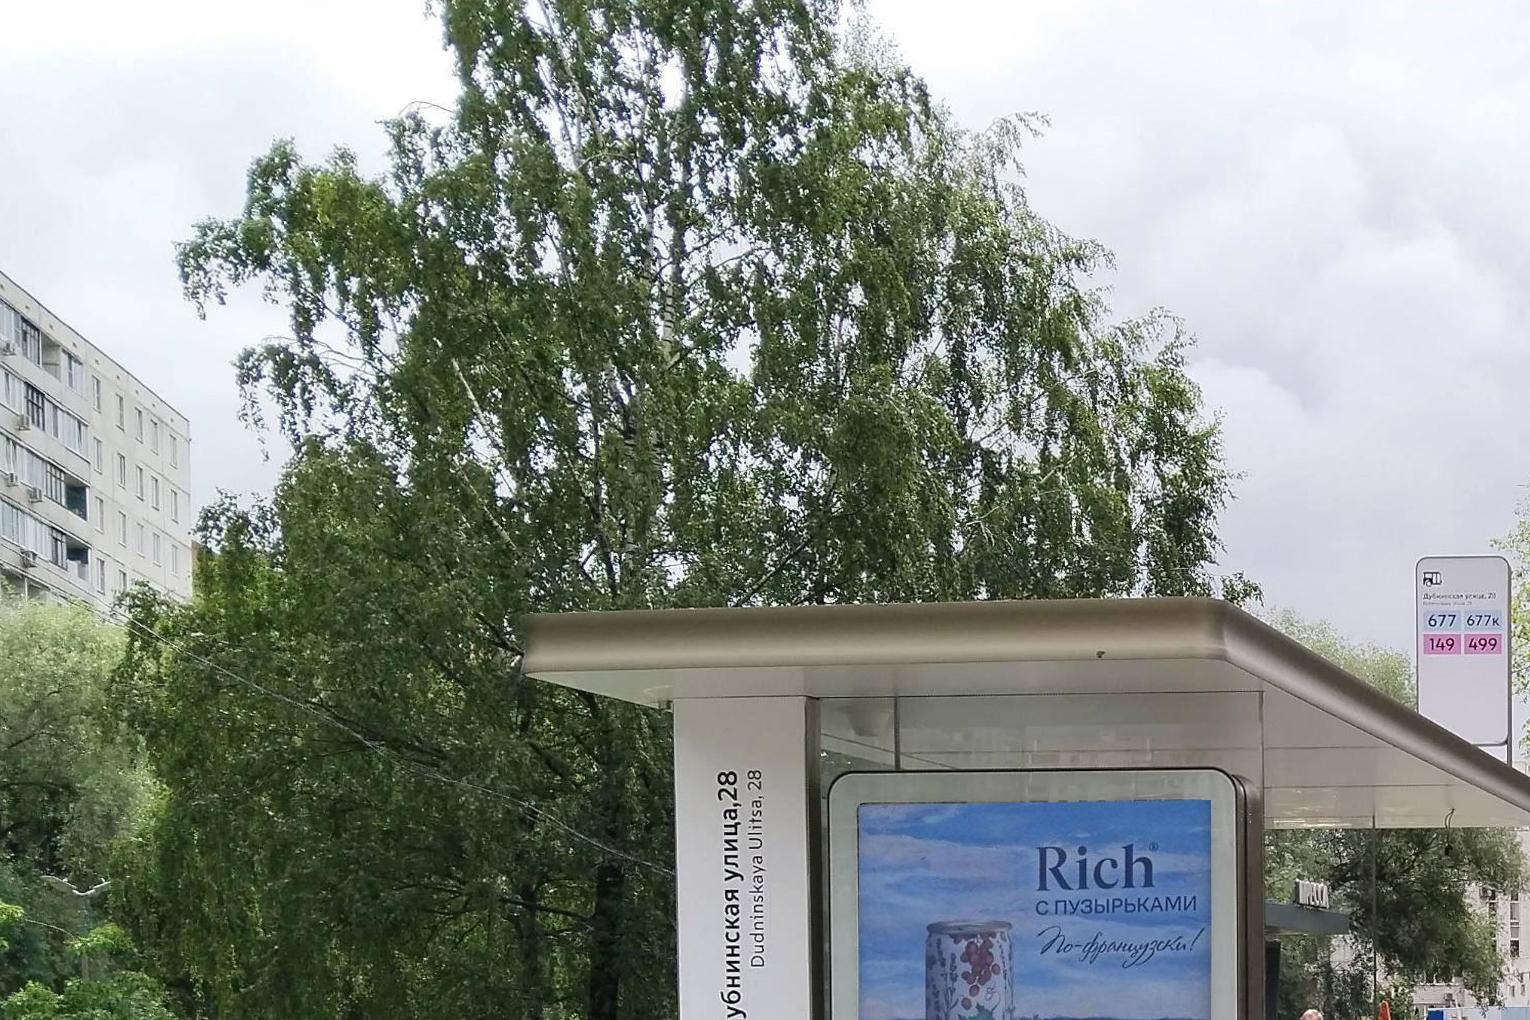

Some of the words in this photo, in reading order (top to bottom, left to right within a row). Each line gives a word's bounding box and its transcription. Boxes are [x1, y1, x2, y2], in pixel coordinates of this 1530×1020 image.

[1428, 614, 1457, 627] 677
[1429, 637, 1455, 651] 149
[1469, 637, 1498, 651] 499
[747, 769, 762, 791] 28
[748, 796, 765, 850] Ulitsa,
[1035, 843, 1155, 891] Rich
[749, 855, 767, 968] Dudninskaya
[1035, 900, 1049, 916] С
[1055, 895, 1197, 915] ПУЗЫРЬКАМИ
